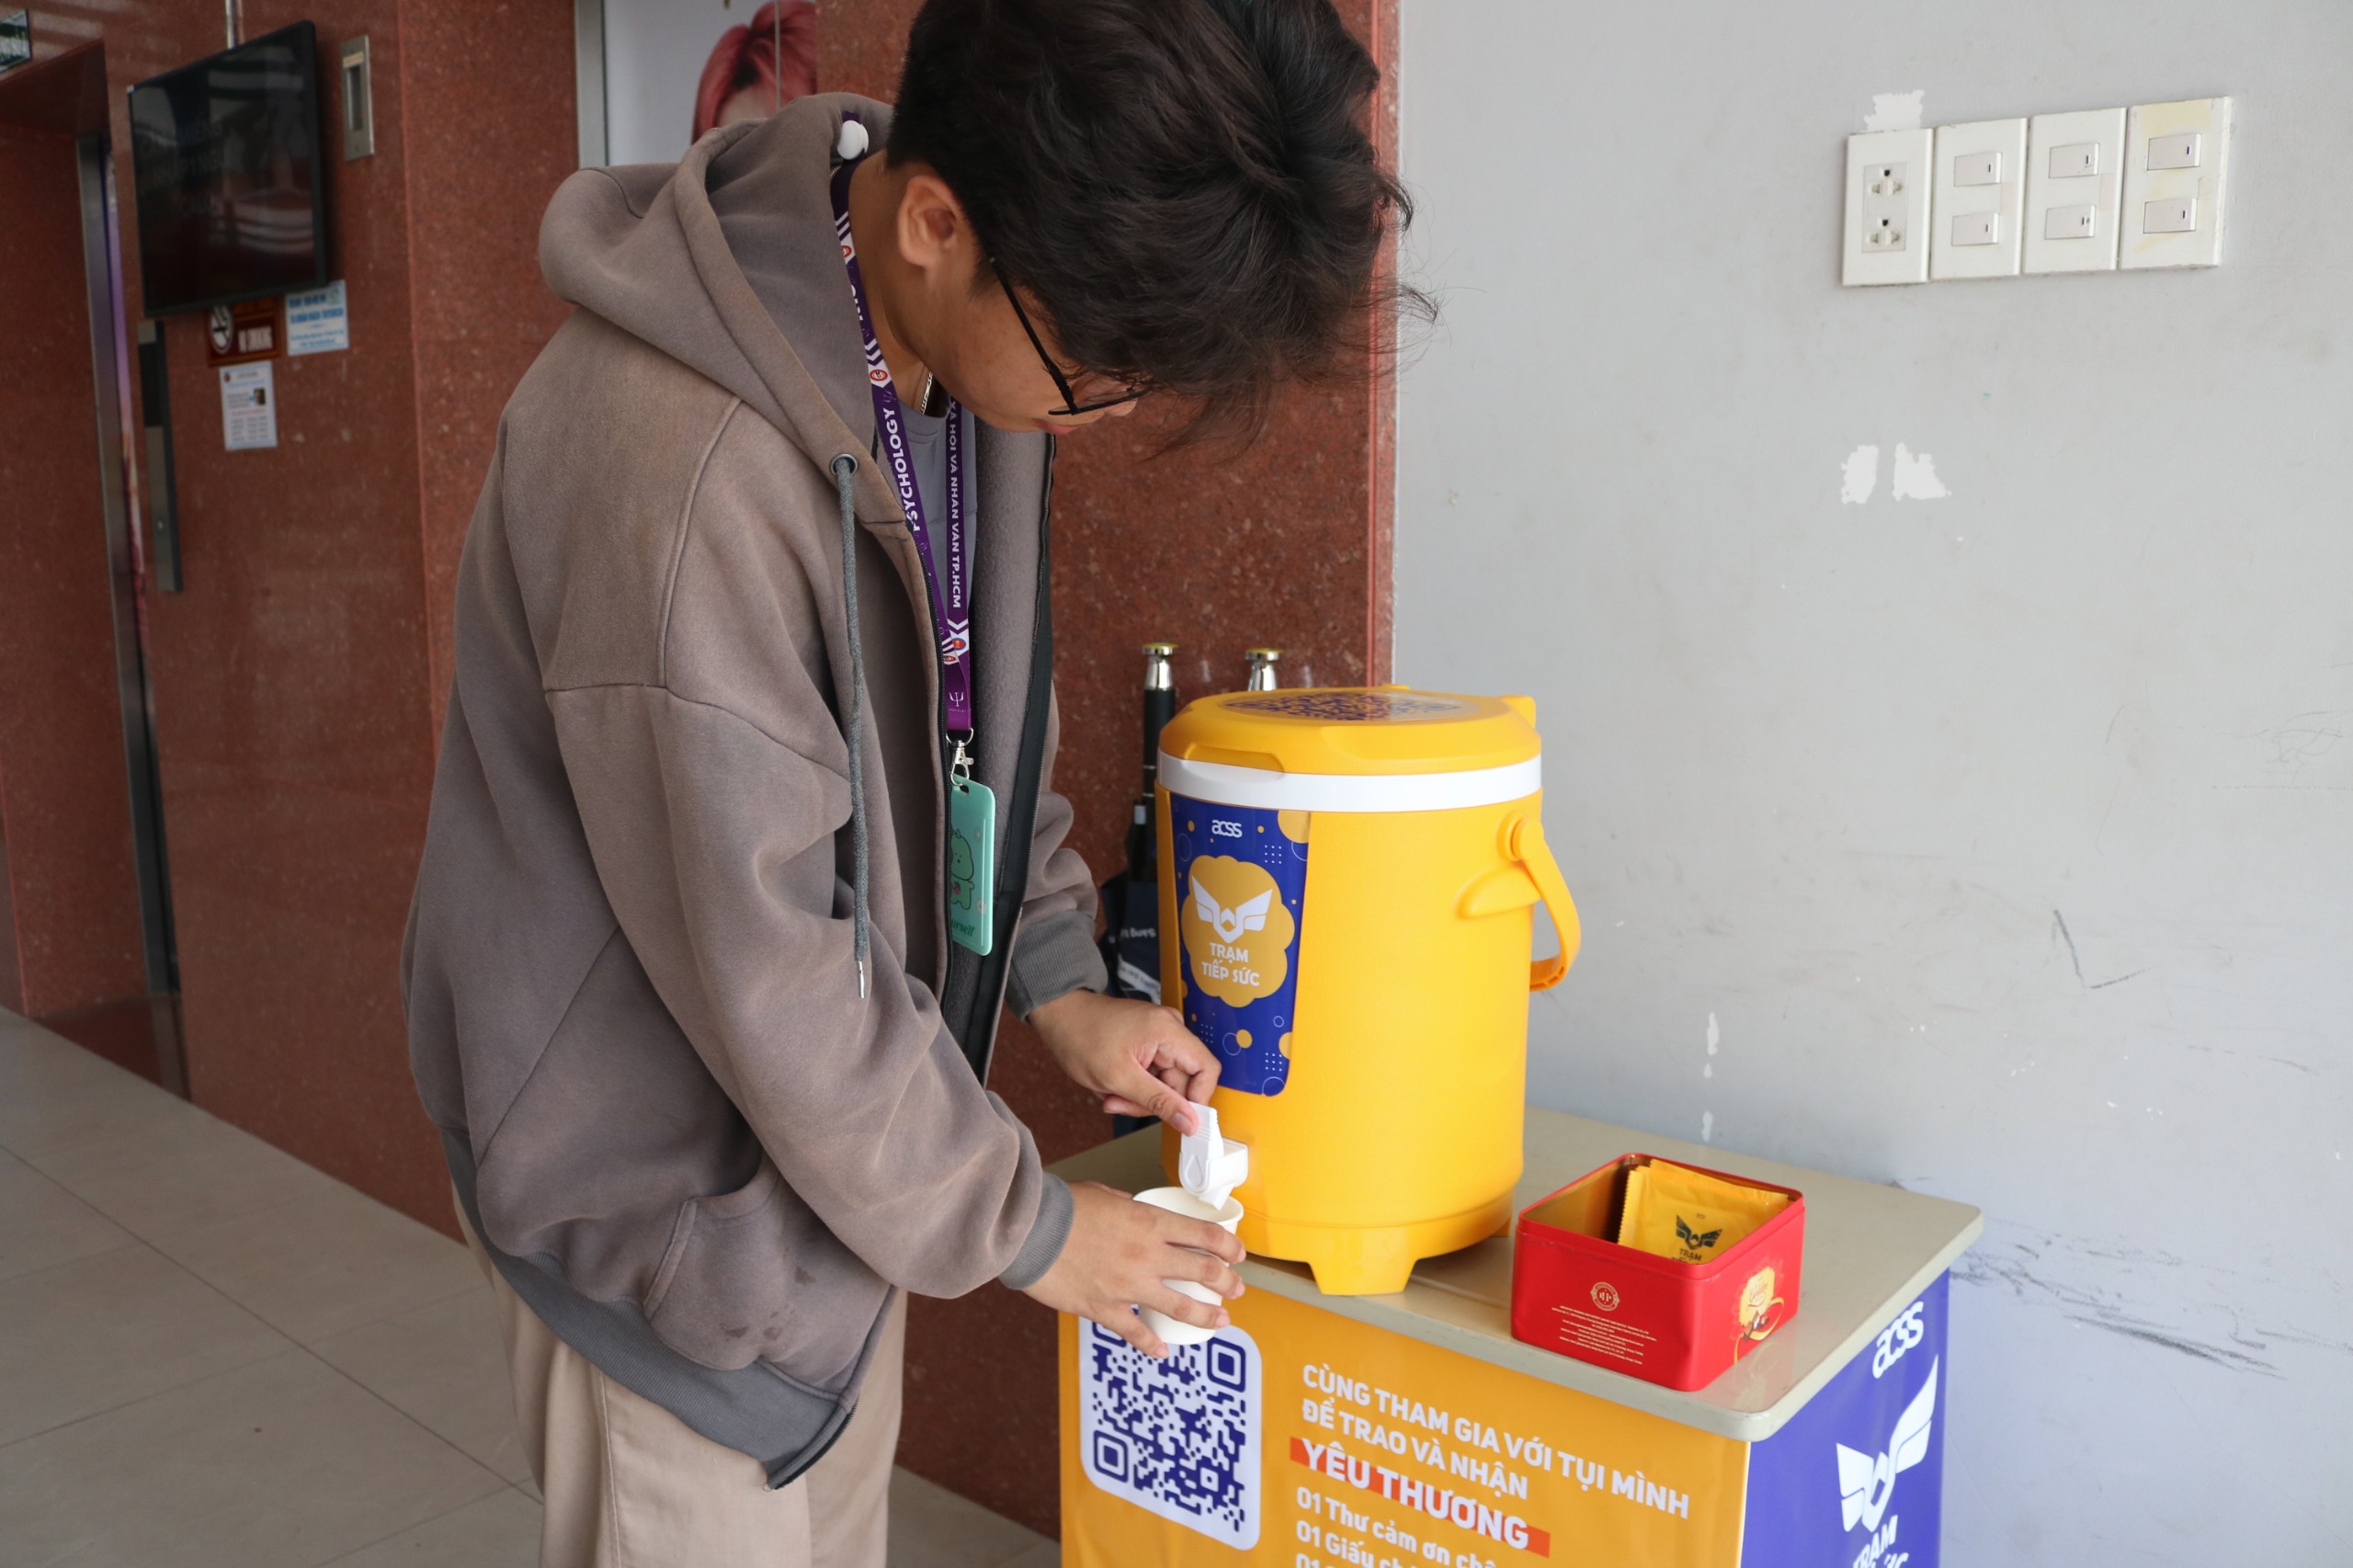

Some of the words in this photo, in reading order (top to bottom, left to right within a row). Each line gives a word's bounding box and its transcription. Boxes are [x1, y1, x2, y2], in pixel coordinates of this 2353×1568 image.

[951, 555, 961, 608] TP.HCM
[1201, 959, 1230, 981] TIẾP
[1233, 967, 1260, 987] SỨC
[1210, 942, 1249, 964] TRẠM
[1302, 1363, 1371, 1406] CÙNG
[1374, 1388, 1449, 1436] THAM
[1454, 1417, 1501, 1454] GIA
[1504, 1432, 1552, 1471] VỚI
[1557, 1450, 1605, 1492] TỤI
[1611, 1470, 1689, 1519] MÌNH
[1302, 1396, 1336, 1430] ĐỂ
[1338, 1411, 1407, 1455] TRAO
[1411, 1437, 1446, 1471] VÀ
[1450, 1451, 1528, 1500] NHẬN
[1297, 1486, 1322, 1515] 01
[1324, 1496, 1370, 1533] Thư
[1372, 1519, 1418, 1554] cảm
[1422, 1542, 1450, 1566] ơn
[1302, 1437, 1371, 1489] YÊU
[1376, 1466, 1529, 1549] THƯƠNG
[1296, 1520, 1321, 1548] 01
